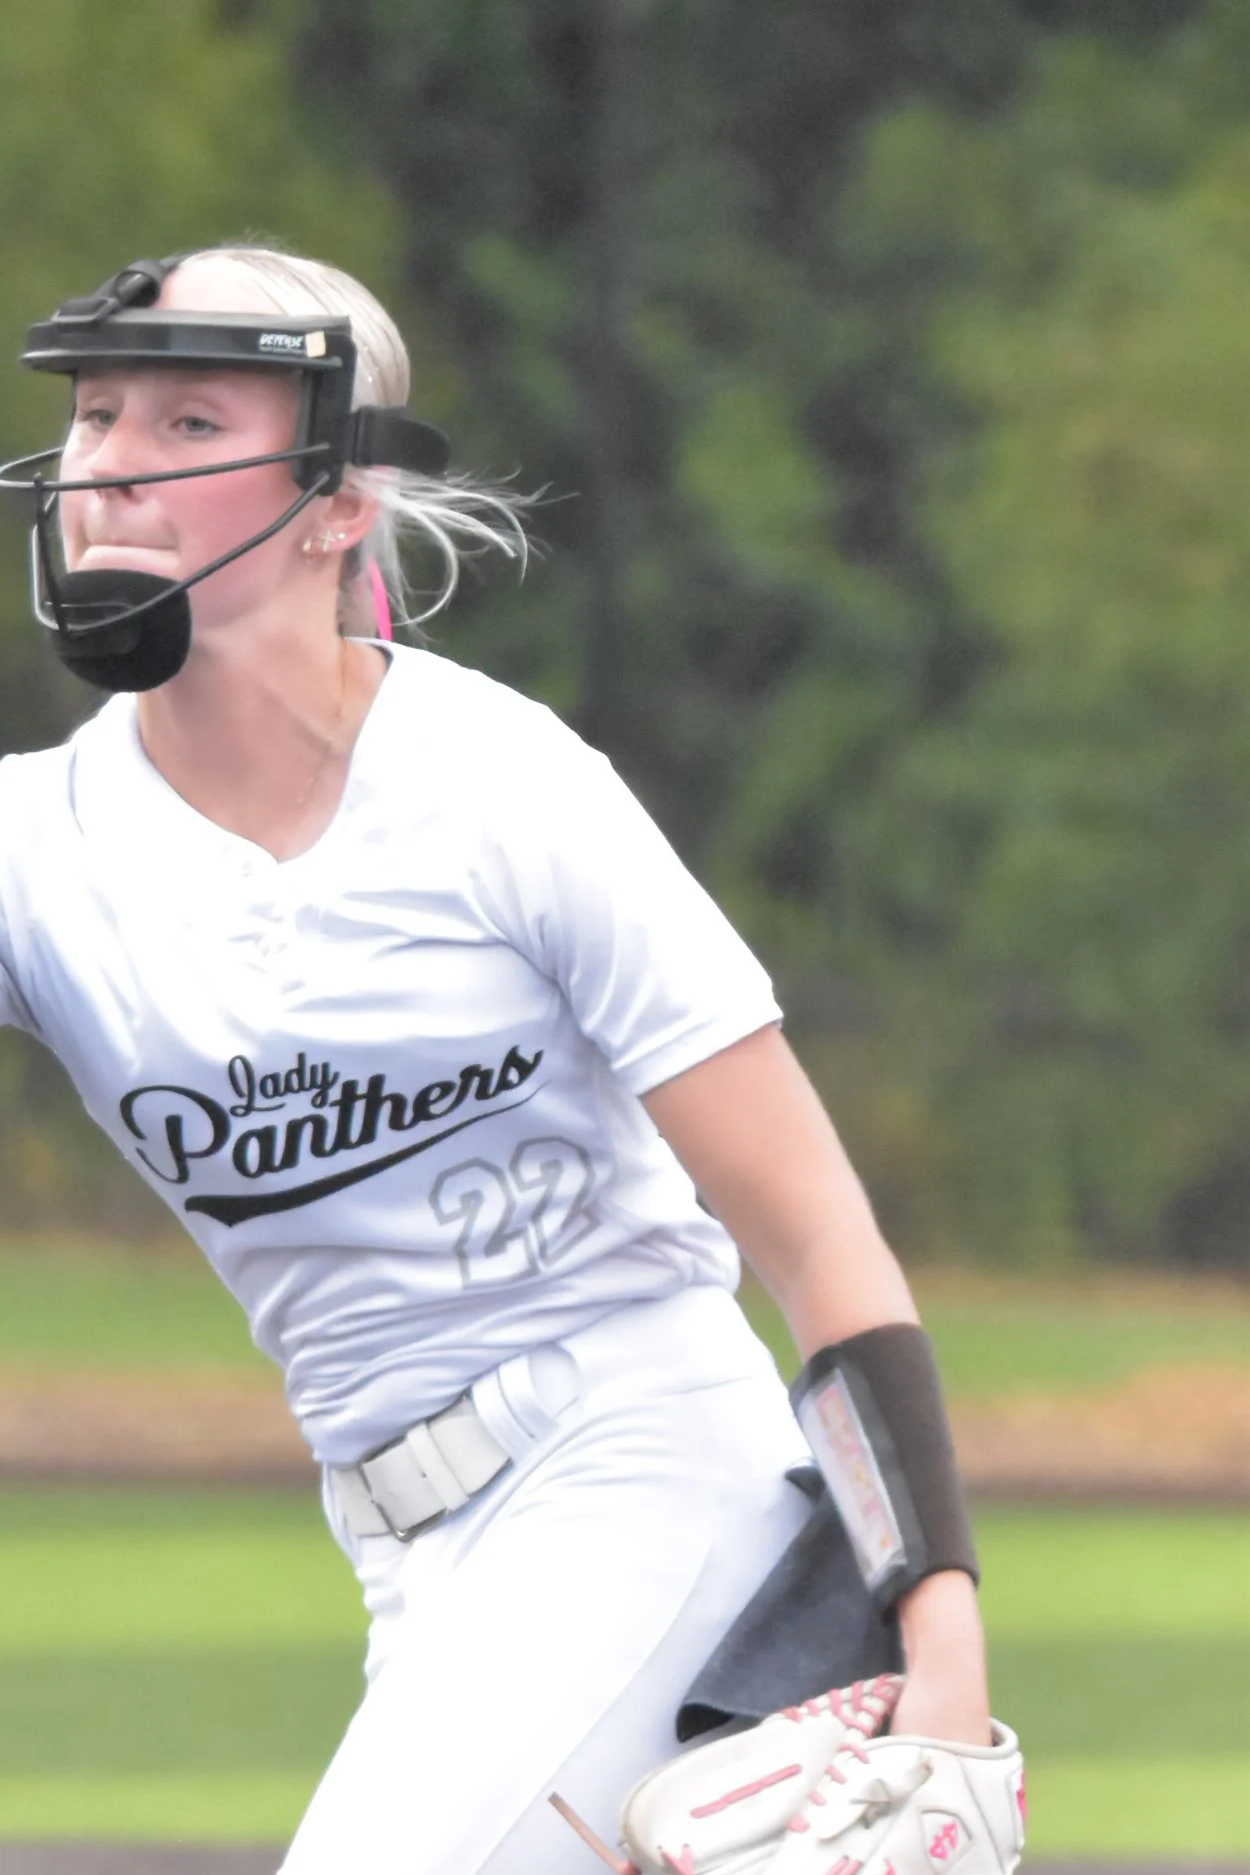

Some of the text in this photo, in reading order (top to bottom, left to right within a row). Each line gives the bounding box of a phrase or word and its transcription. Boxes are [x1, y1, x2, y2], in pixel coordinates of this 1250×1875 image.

[120, 1044, 545, 1185] Panthers
[228, 1051, 340, 1118] Lady
[429, 1136, 602, 1290] 22
